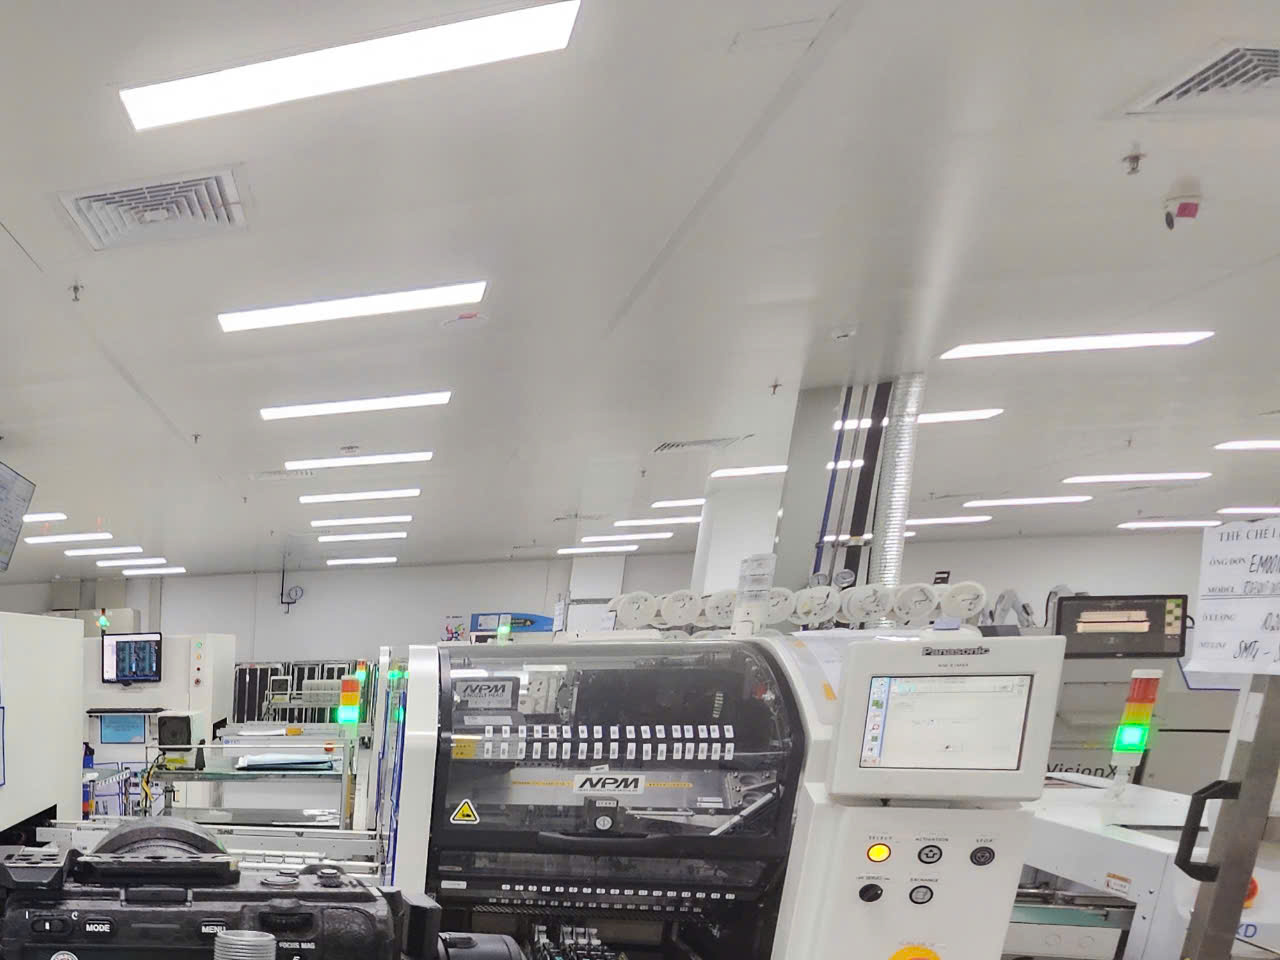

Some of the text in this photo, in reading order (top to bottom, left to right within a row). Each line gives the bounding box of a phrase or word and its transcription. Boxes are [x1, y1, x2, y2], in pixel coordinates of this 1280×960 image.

[922, 645, 990, 656] Panasonic
[463, 684, 506, 693] NPM
[578, 777, 640, 789] NPM
[85, 924, 111, 932] MODE
[201, 925, 226, 933] MENU
